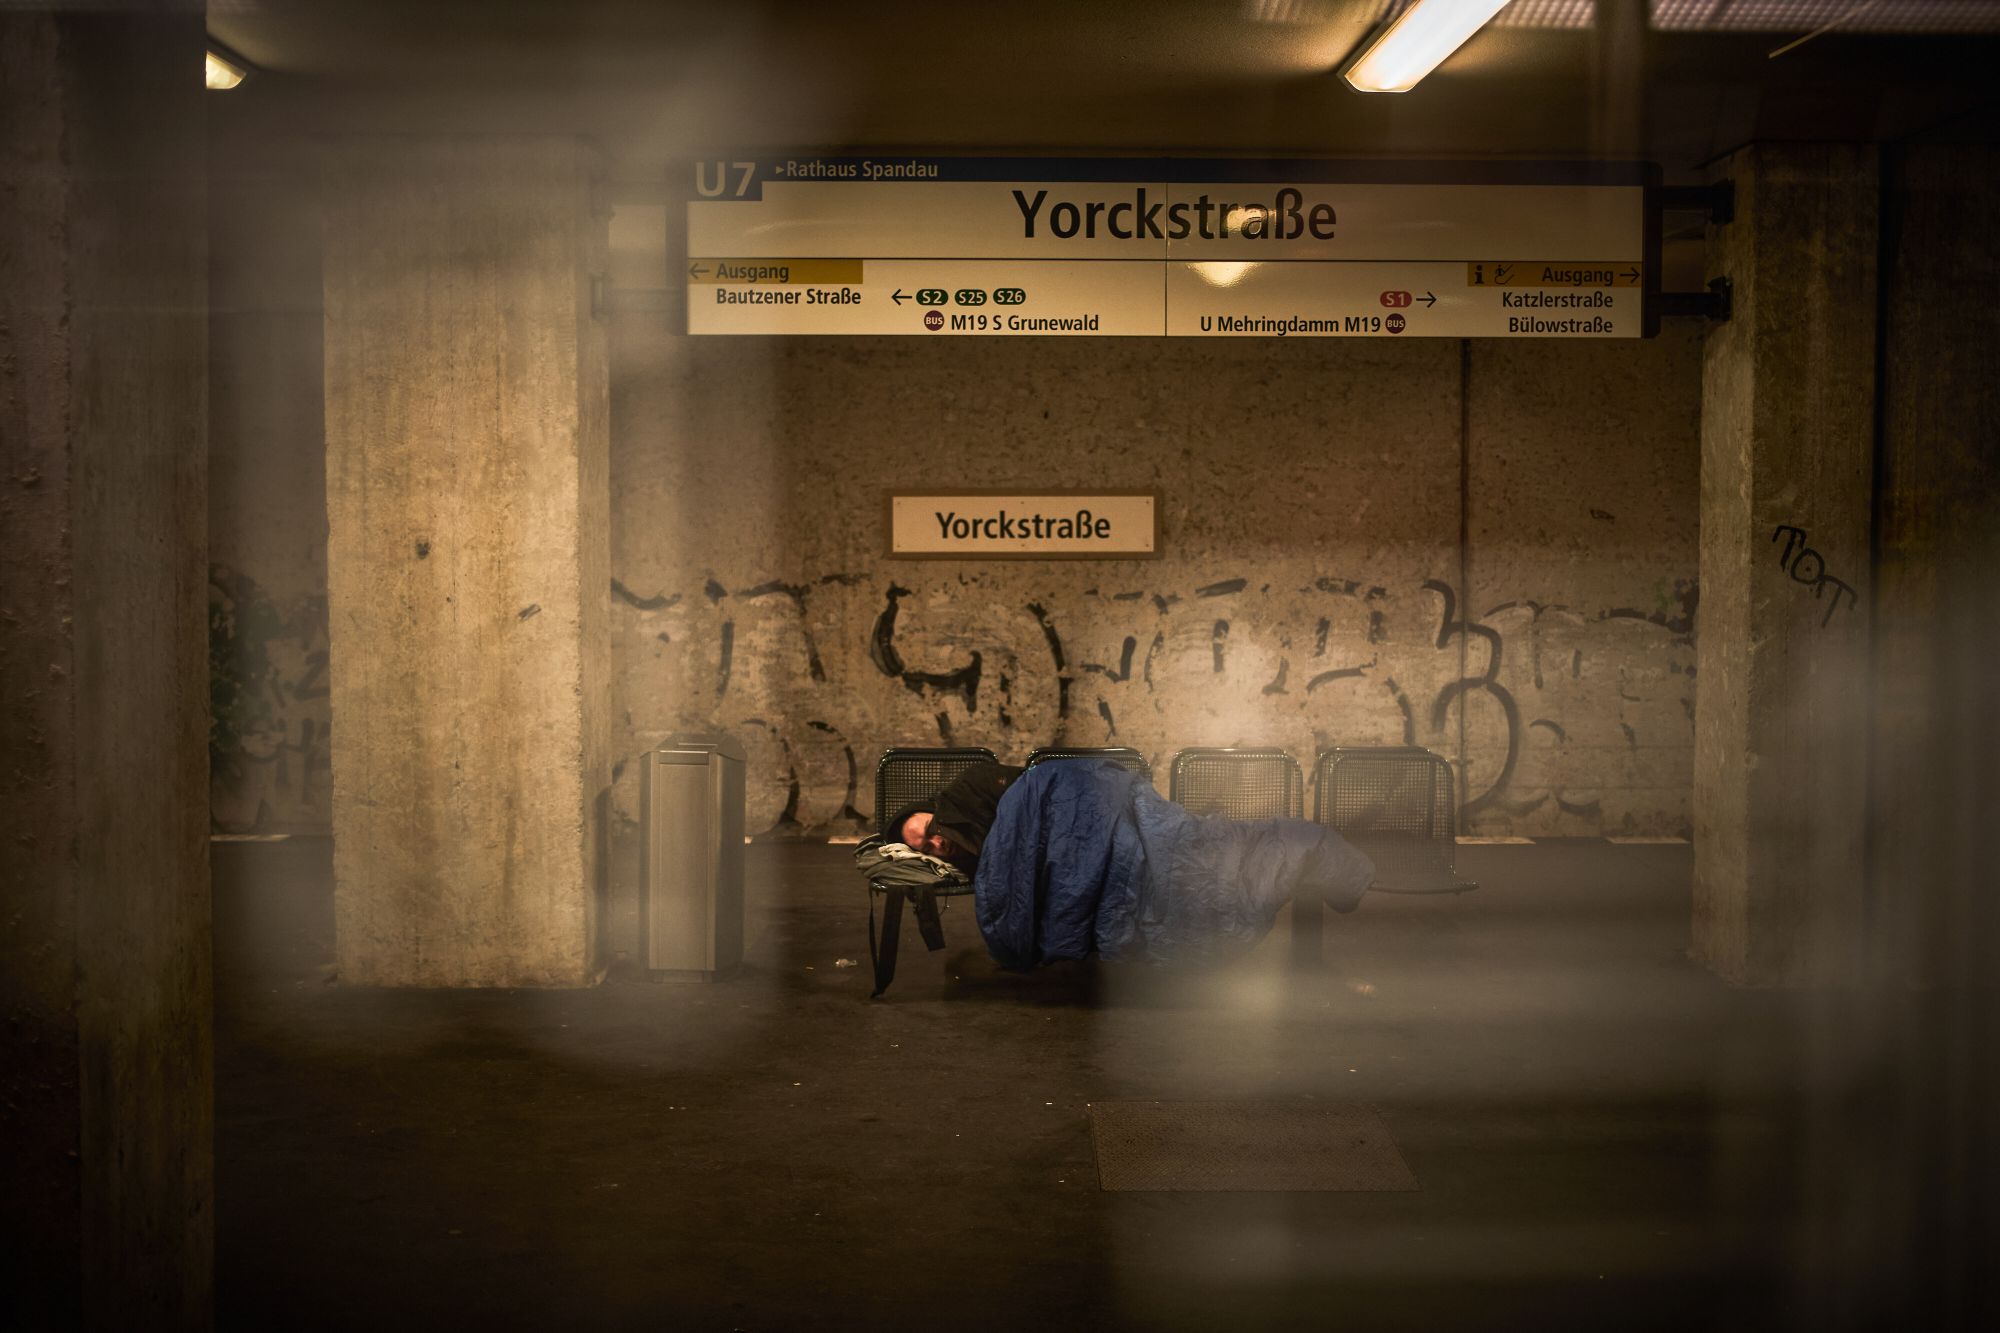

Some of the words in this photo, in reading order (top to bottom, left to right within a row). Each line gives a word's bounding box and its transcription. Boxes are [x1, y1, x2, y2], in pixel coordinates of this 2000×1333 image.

[695, 161, 756, 197] U7
[787, 161, 857, 177] Rathaus
[862, 161, 938, 180] Spandau
[1012, 187, 1337, 240] Yorckstraße
[716, 264, 790, 283] Ausgang
[1541, 267, 1614, 286] Ausgang
[716, 289, 801, 305] Bautzener
[806, 288, 862, 305] Straße
[922, 291, 942, 304] S2
[959, 291, 984, 304] S25
[997, 290, 1023, 303] S26
[1386, 293, 1406, 306] S1
[1502, 291, 1614, 309] Katzlerstraße
[925, 316, 943, 327] BUS
[951, 315, 987, 331] M19
[993, 315, 1002, 331] S
[1007, 314, 1099, 331] Grunewald
[1200, 317, 1212, 333] U
[1217, 317, 1340, 336] Mehringdamm
[1344, 317, 1381, 333] M19
[1386, 318, 1405, 330] BUS
[1509, 316, 1614, 334] Bülowstraße
[936, 510, 1111, 539] Yorckstraße
